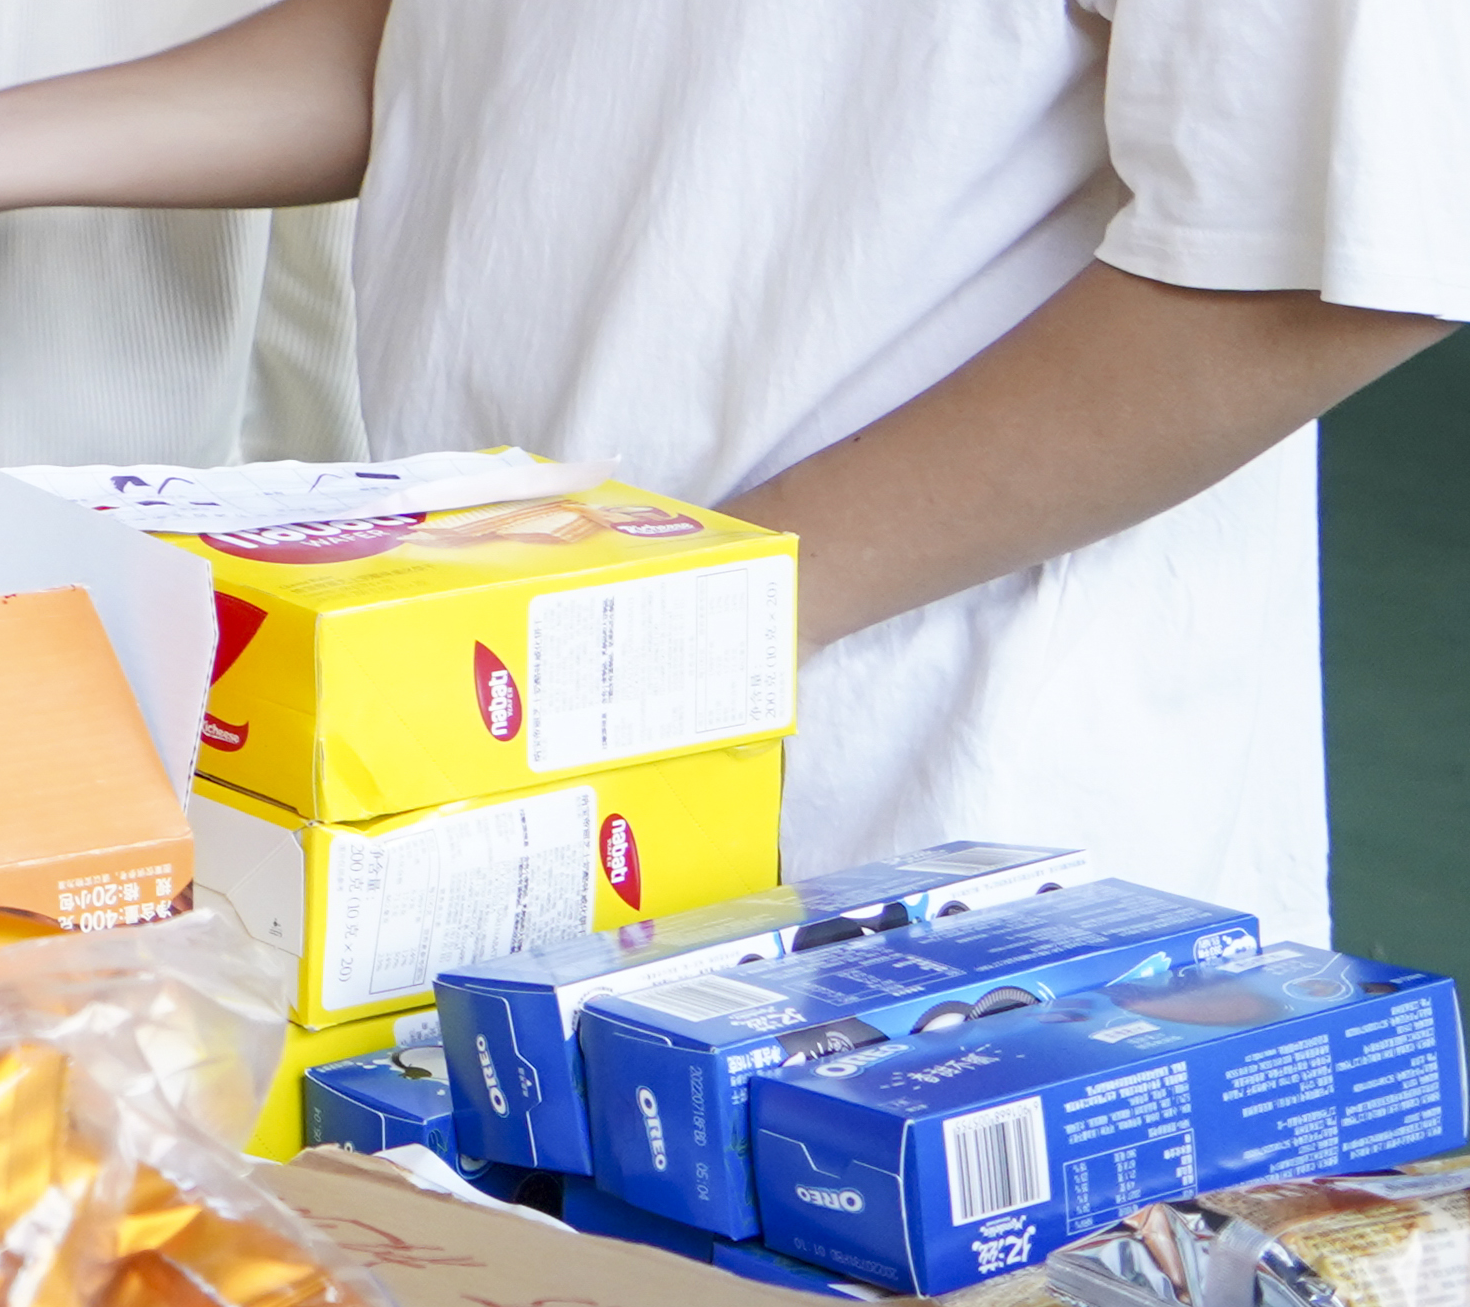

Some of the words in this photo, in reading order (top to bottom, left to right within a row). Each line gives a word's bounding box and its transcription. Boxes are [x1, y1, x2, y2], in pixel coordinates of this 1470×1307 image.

[299, 529, 391, 552] WAFER
[618, 519, 693, 538] Richeese
[489, 669, 508, 736] nabati
[766, 690, 778, 720] 200
[348, 843, 363, 873] 200
[608, 815, 628, 884] nabati
[80, 900, 172, 934] 净含量:400
[476, 1035, 508, 1117] OREO
[638, 1088, 668, 1170] OREO
[797, 1187, 863, 1212] OREO
[972, 1225, 1036, 1274] 亿滋
